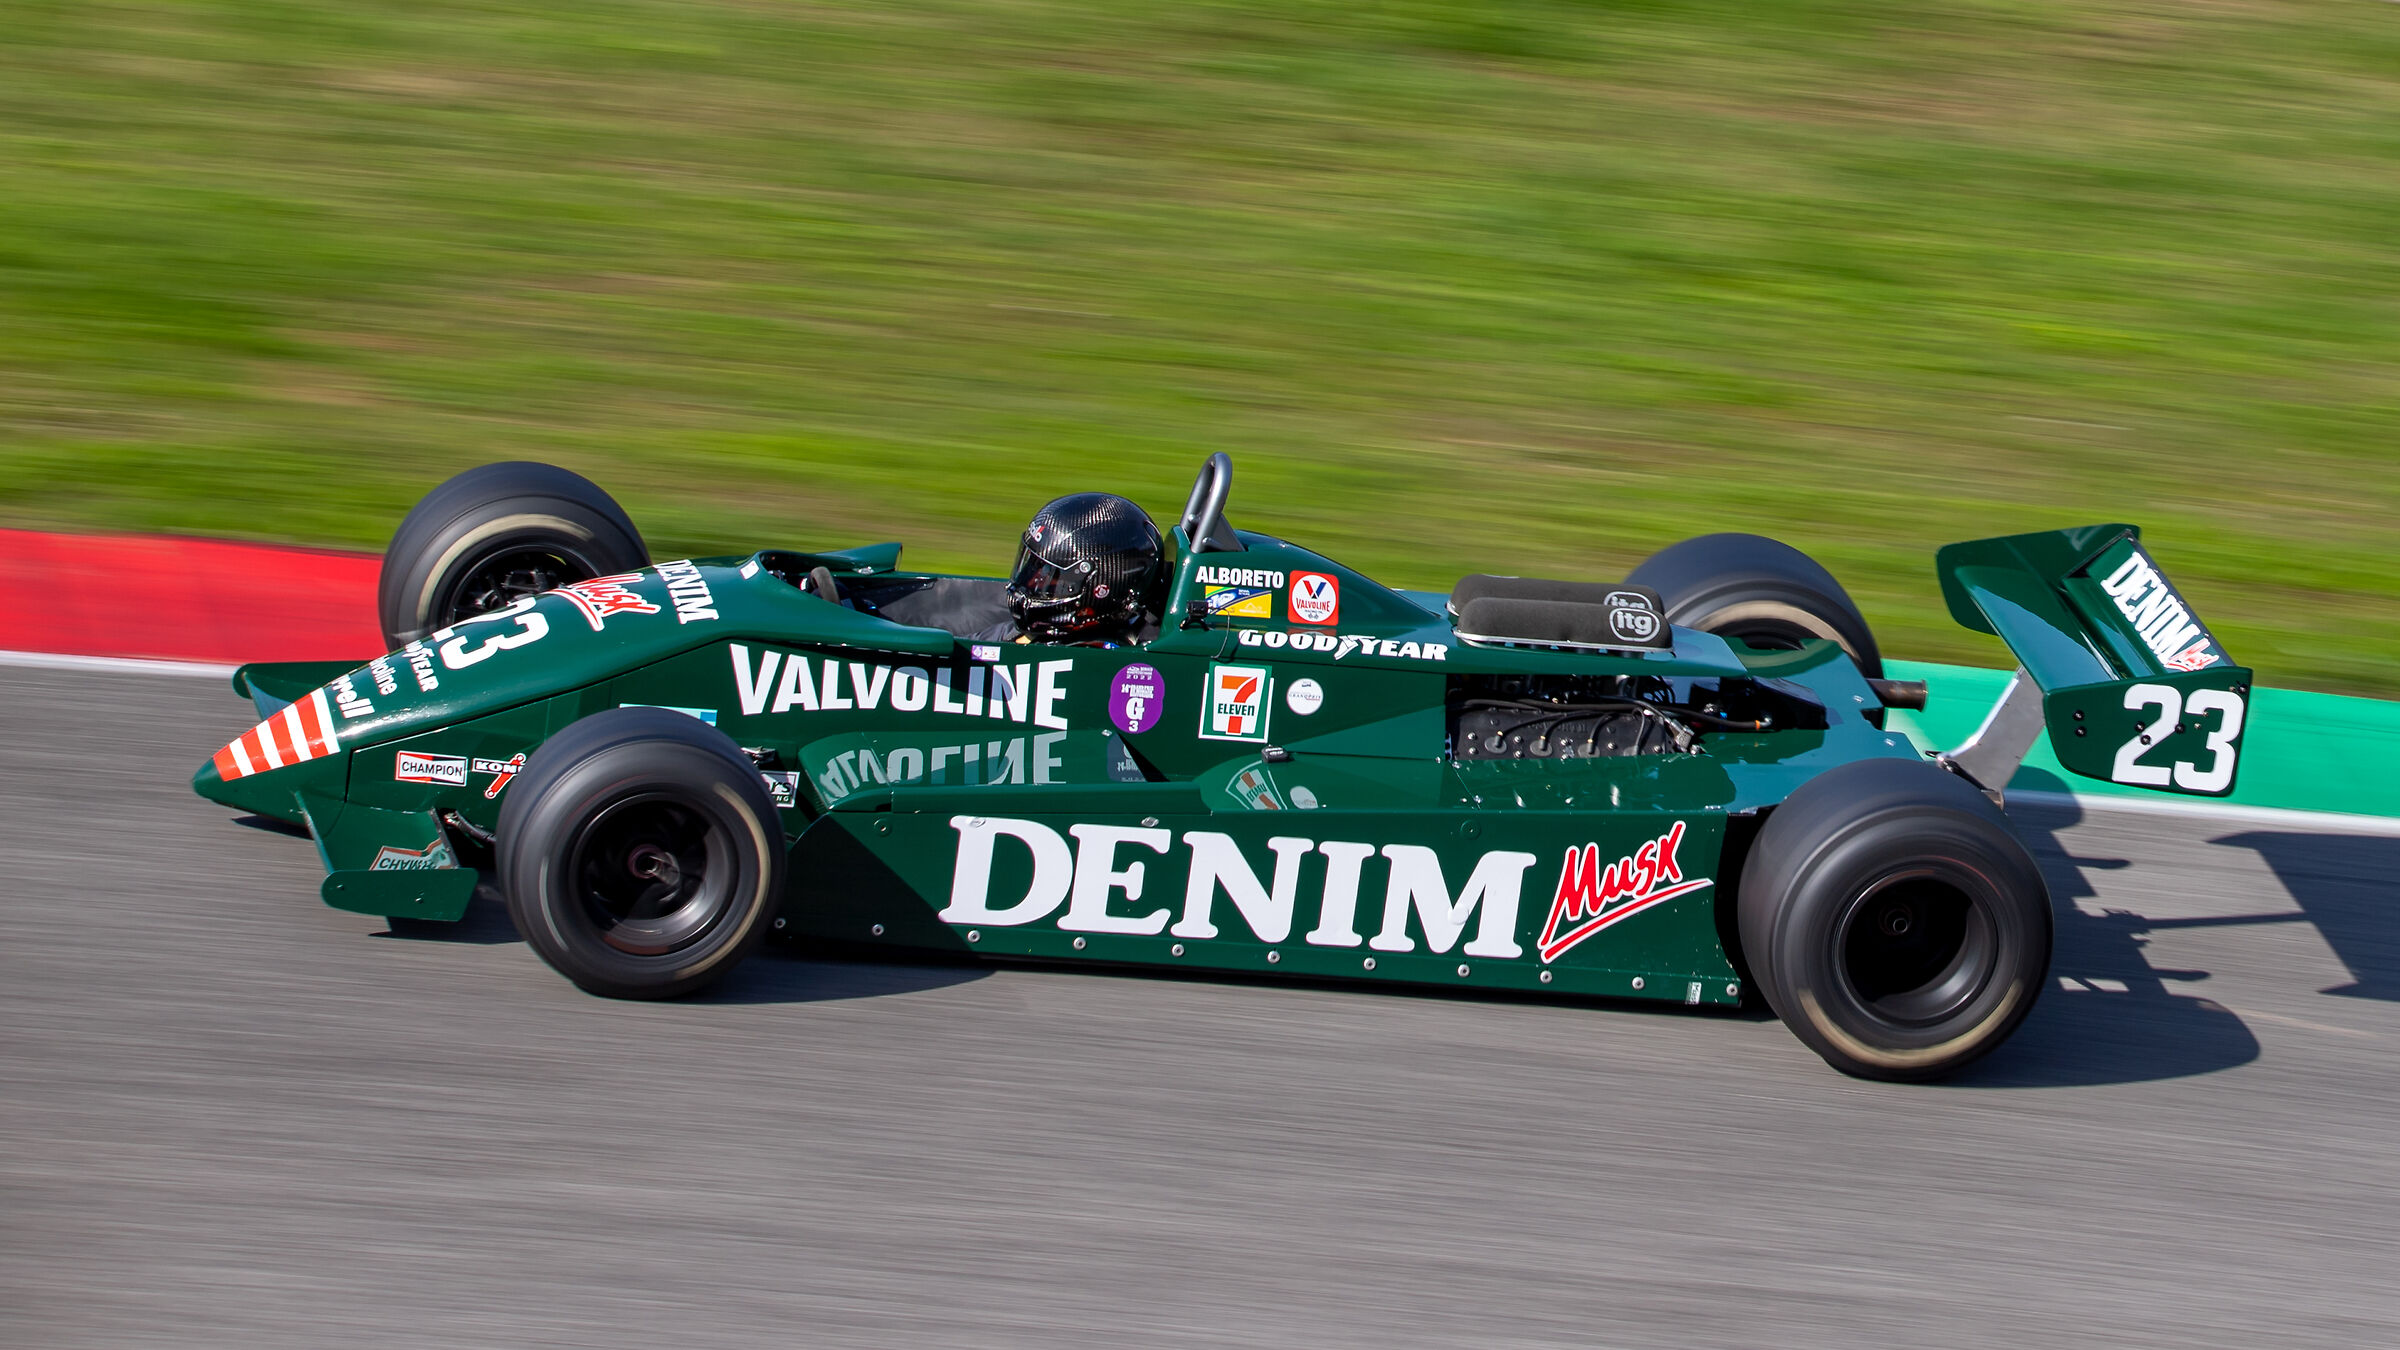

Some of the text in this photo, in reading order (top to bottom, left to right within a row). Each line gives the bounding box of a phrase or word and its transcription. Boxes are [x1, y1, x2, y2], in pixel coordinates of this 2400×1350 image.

[653, 559, 719, 624] DENIM
[1195, 566, 1284, 589] ALBORETO
[1296, 598, 1330, 613] VALVOLINE
[2100, 551, 2201, 666] DENIM
[1616, 611, 1652, 635] itg
[1238, 629, 1448, 661] GOODYEAR
[729, 643, 1073, 730] VALVOLINE
[1126, 697, 1145, 721] G
[1128, 720, 1139, 732] 3
[2112, 683, 2244, 792] 23
[402, 761, 463, 777] CHAMPION
[938, 815, 1537, 959] DENIM
